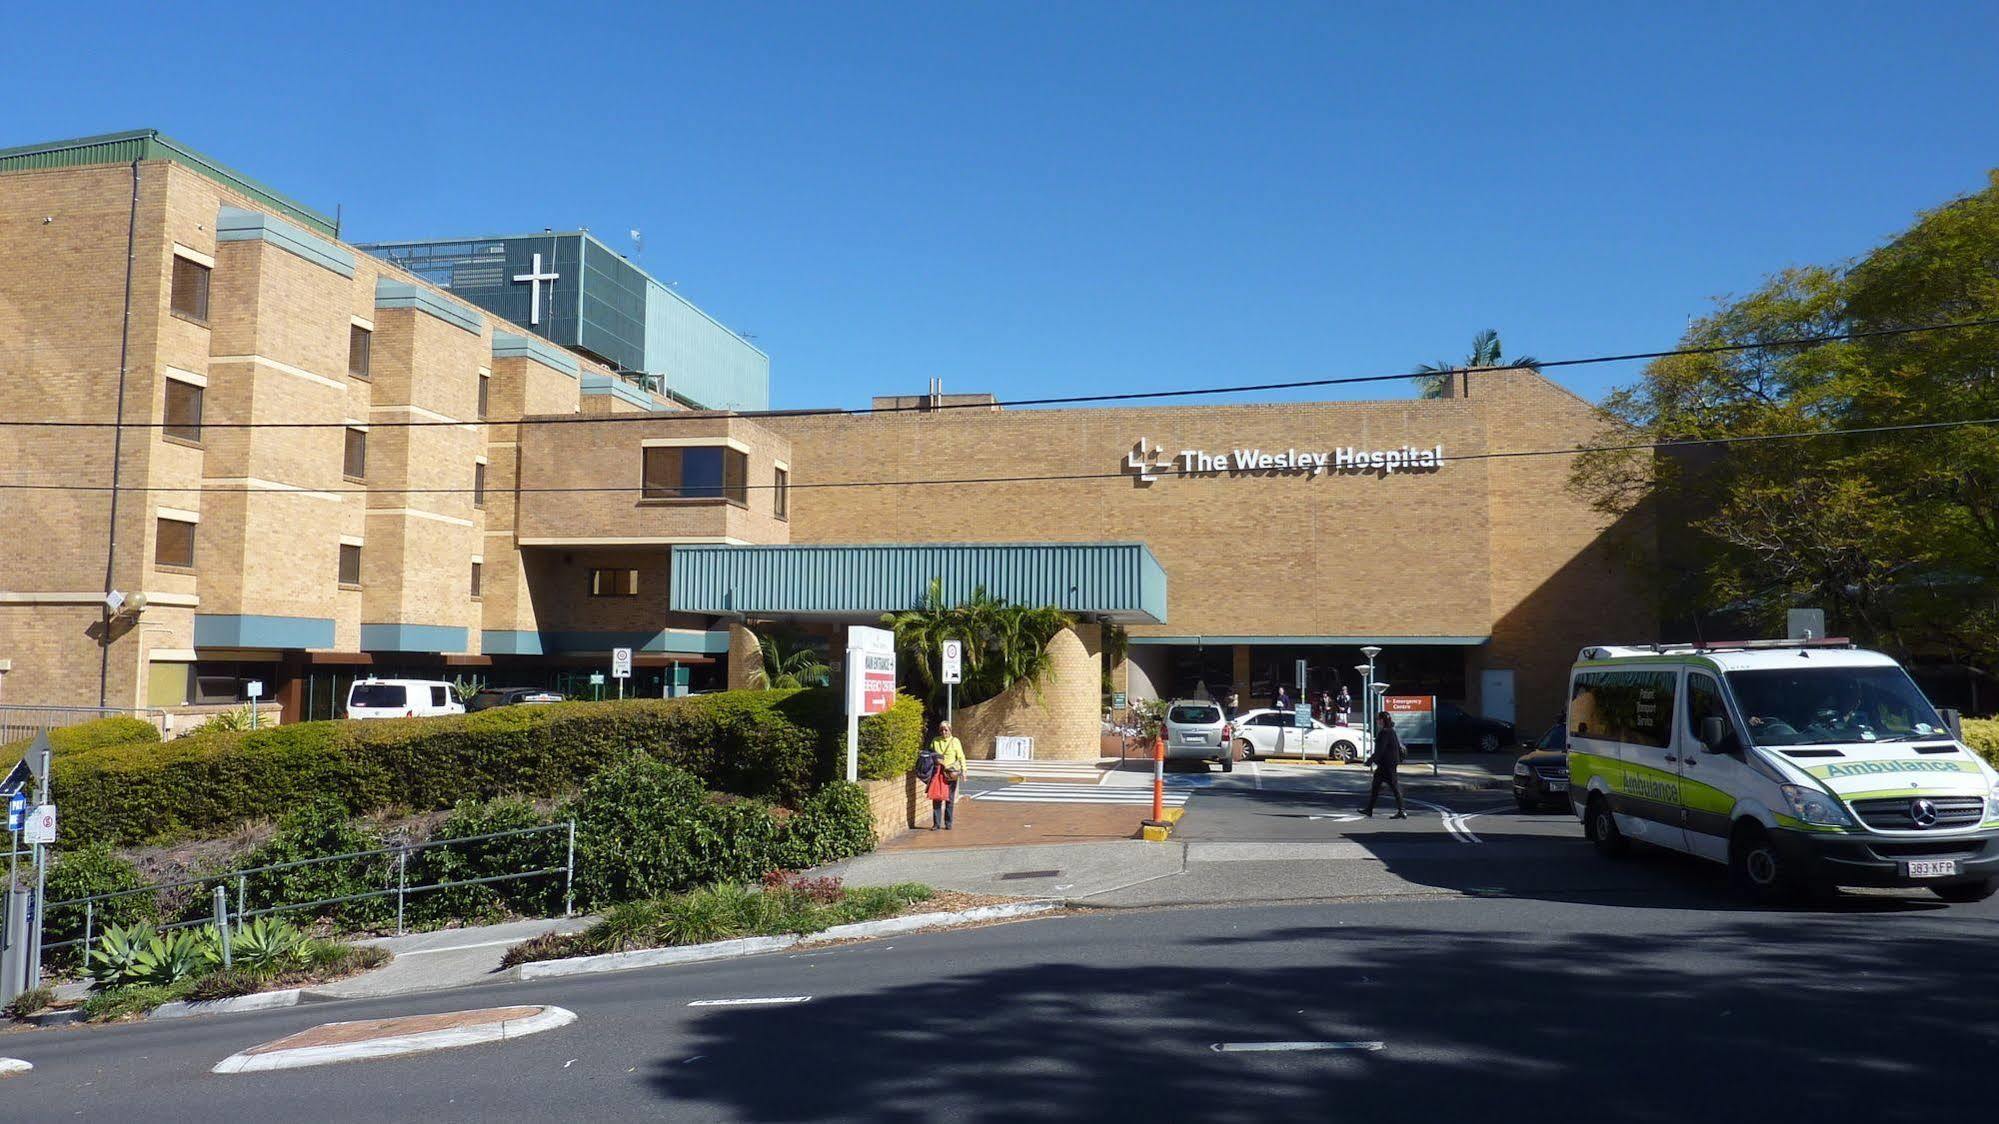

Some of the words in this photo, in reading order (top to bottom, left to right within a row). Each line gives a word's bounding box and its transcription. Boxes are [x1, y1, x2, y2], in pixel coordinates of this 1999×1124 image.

[1181, 450, 1228, 472] The
[1234, 448, 1327, 474] Wesley
[1336, 444, 1445, 473] Hospital
[1827, 759, 1961, 777] Ambulance
[1622, 768, 1679, 802] Ambulance
[1932, 861, 1953, 873] KFP
